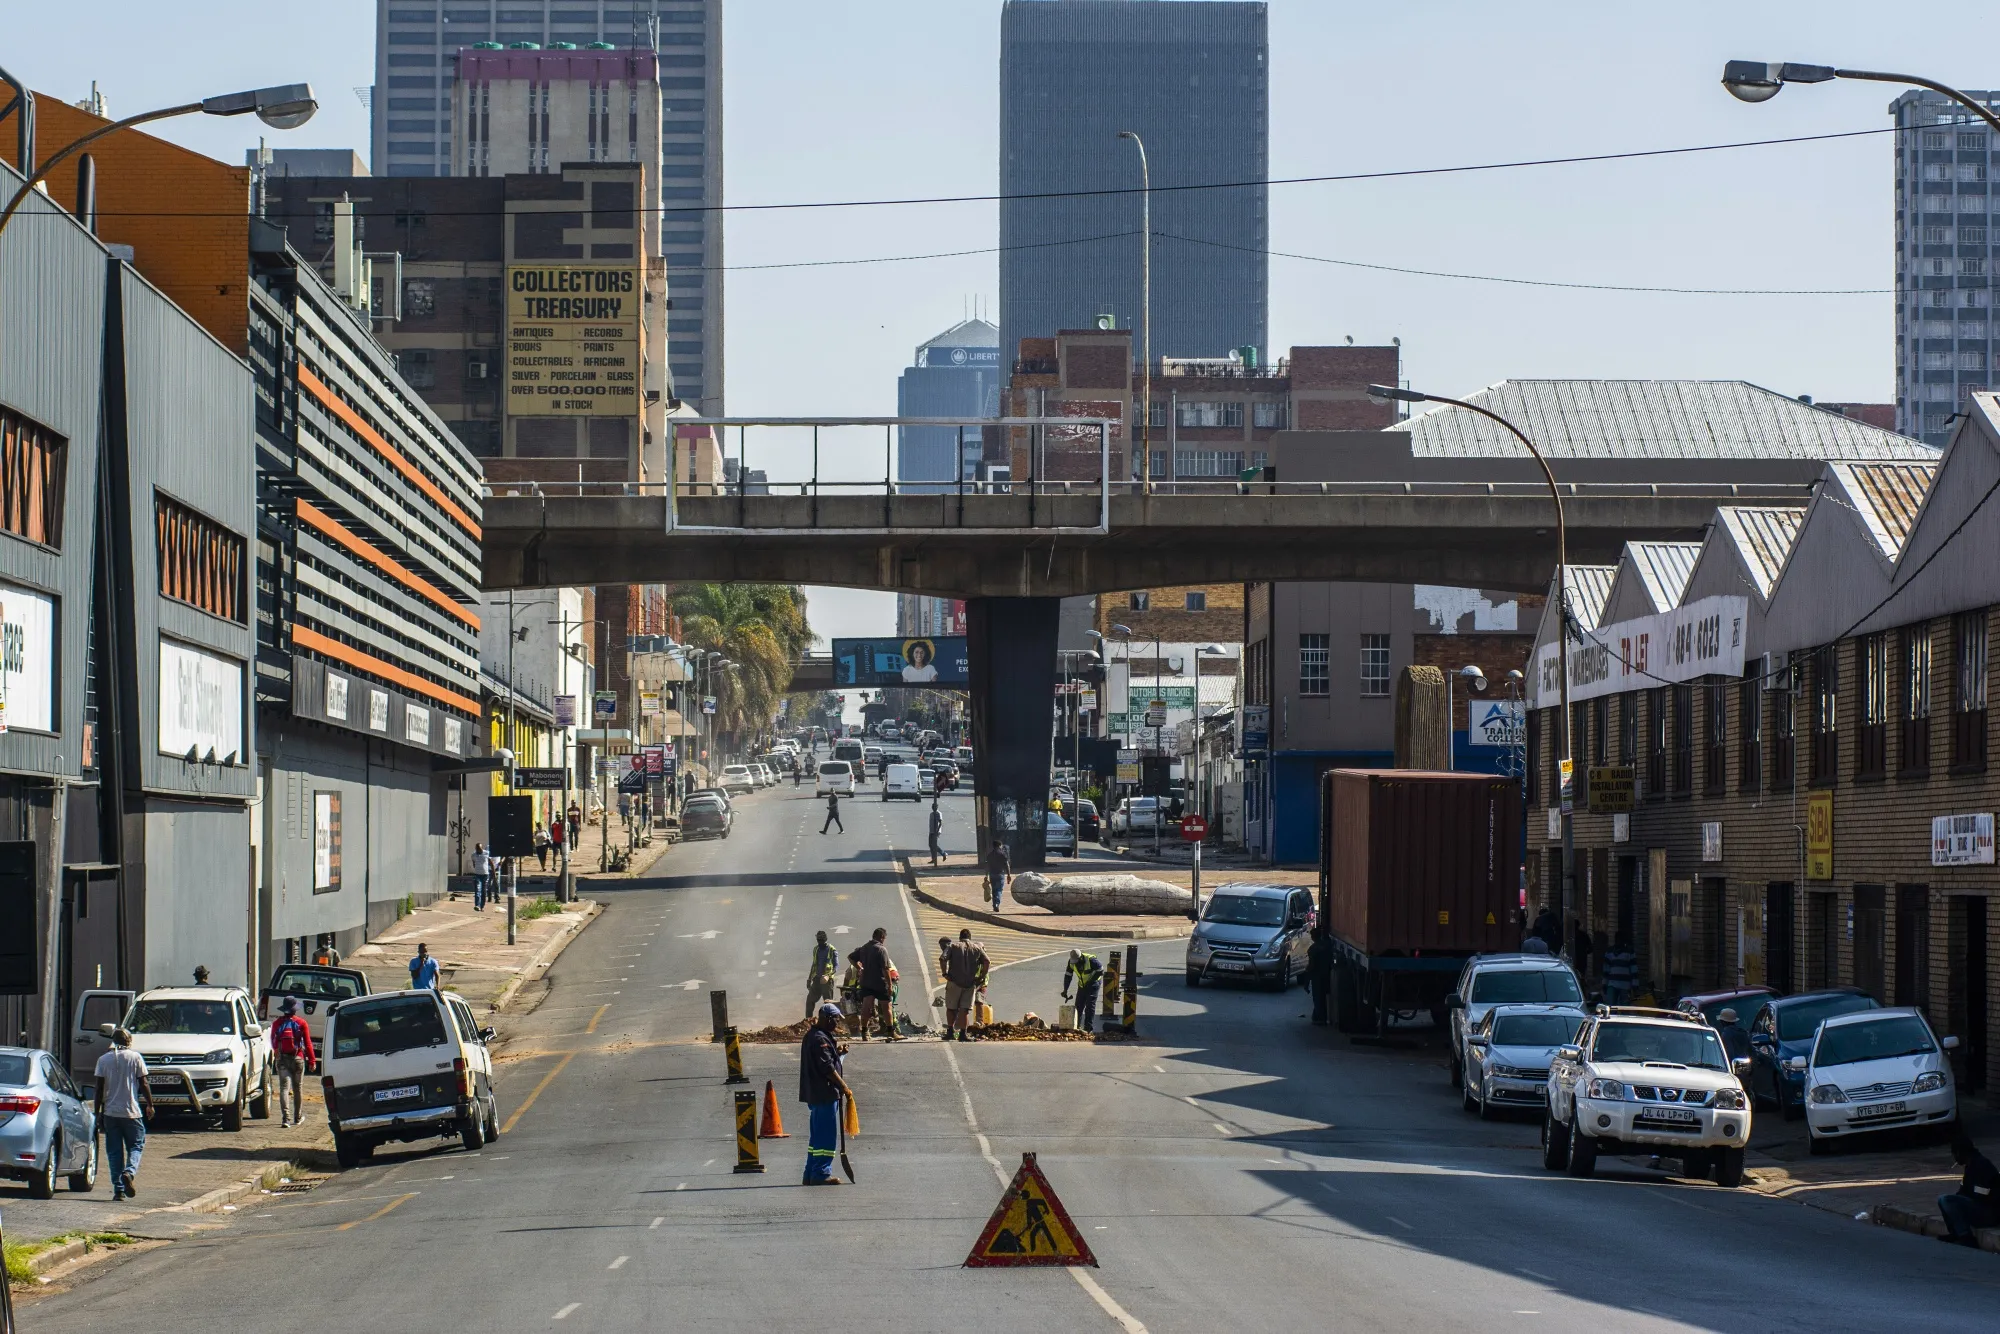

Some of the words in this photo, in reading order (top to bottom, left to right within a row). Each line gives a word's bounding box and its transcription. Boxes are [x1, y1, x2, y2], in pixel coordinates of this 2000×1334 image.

[513, 270, 632, 292] COLLECTORS
[524, 298, 621, 319] TREASURY
[513, 328, 554, 338] ANTIQUES
[584, 328, 623, 338] RECORDS
[513, 342, 542, 352] BOOKS
[584, 342, 614, 352] PRINTS
[513, 356, 573, 366] COLLECTABLES
[584, 356, 624, 366] AFRICANA
[970, 352, 999, 360] LIBERT
[512, 371, 540, 380] SILVER
[551, 371, 596, 380] PORCELAIN
[607, 371, 634, 380] GLASS
[512, 386, 534, 395] OVER
[609, 386, 634, 395] ITEMS
[552, 400, 560, 409] IN
[564, 400, 592, 409] STOCK
[1621, 637, 1630, 677] TO
[1636, 633, 1649, 673] LET
[1612, 770, 1632, 779] RADIO
[1590, 781, 1634, 791] INSTALLATION
[1600, 793, 1628, 802] CENTRE
[1810, 805, 1829, 843] SIBA
[1859, 1107, 1872, 1116] YTG
[1876, 1105, 1888, 1113] 387
[1896, 1102, 1904, 1110] GP
[1645, 1109, 1653, 1117] JL
[1657, 1110, 1665, 1118] 44
[1669, 1111, 1677, 1119] LP
[1684, 1112, 1693, 1120] GP
